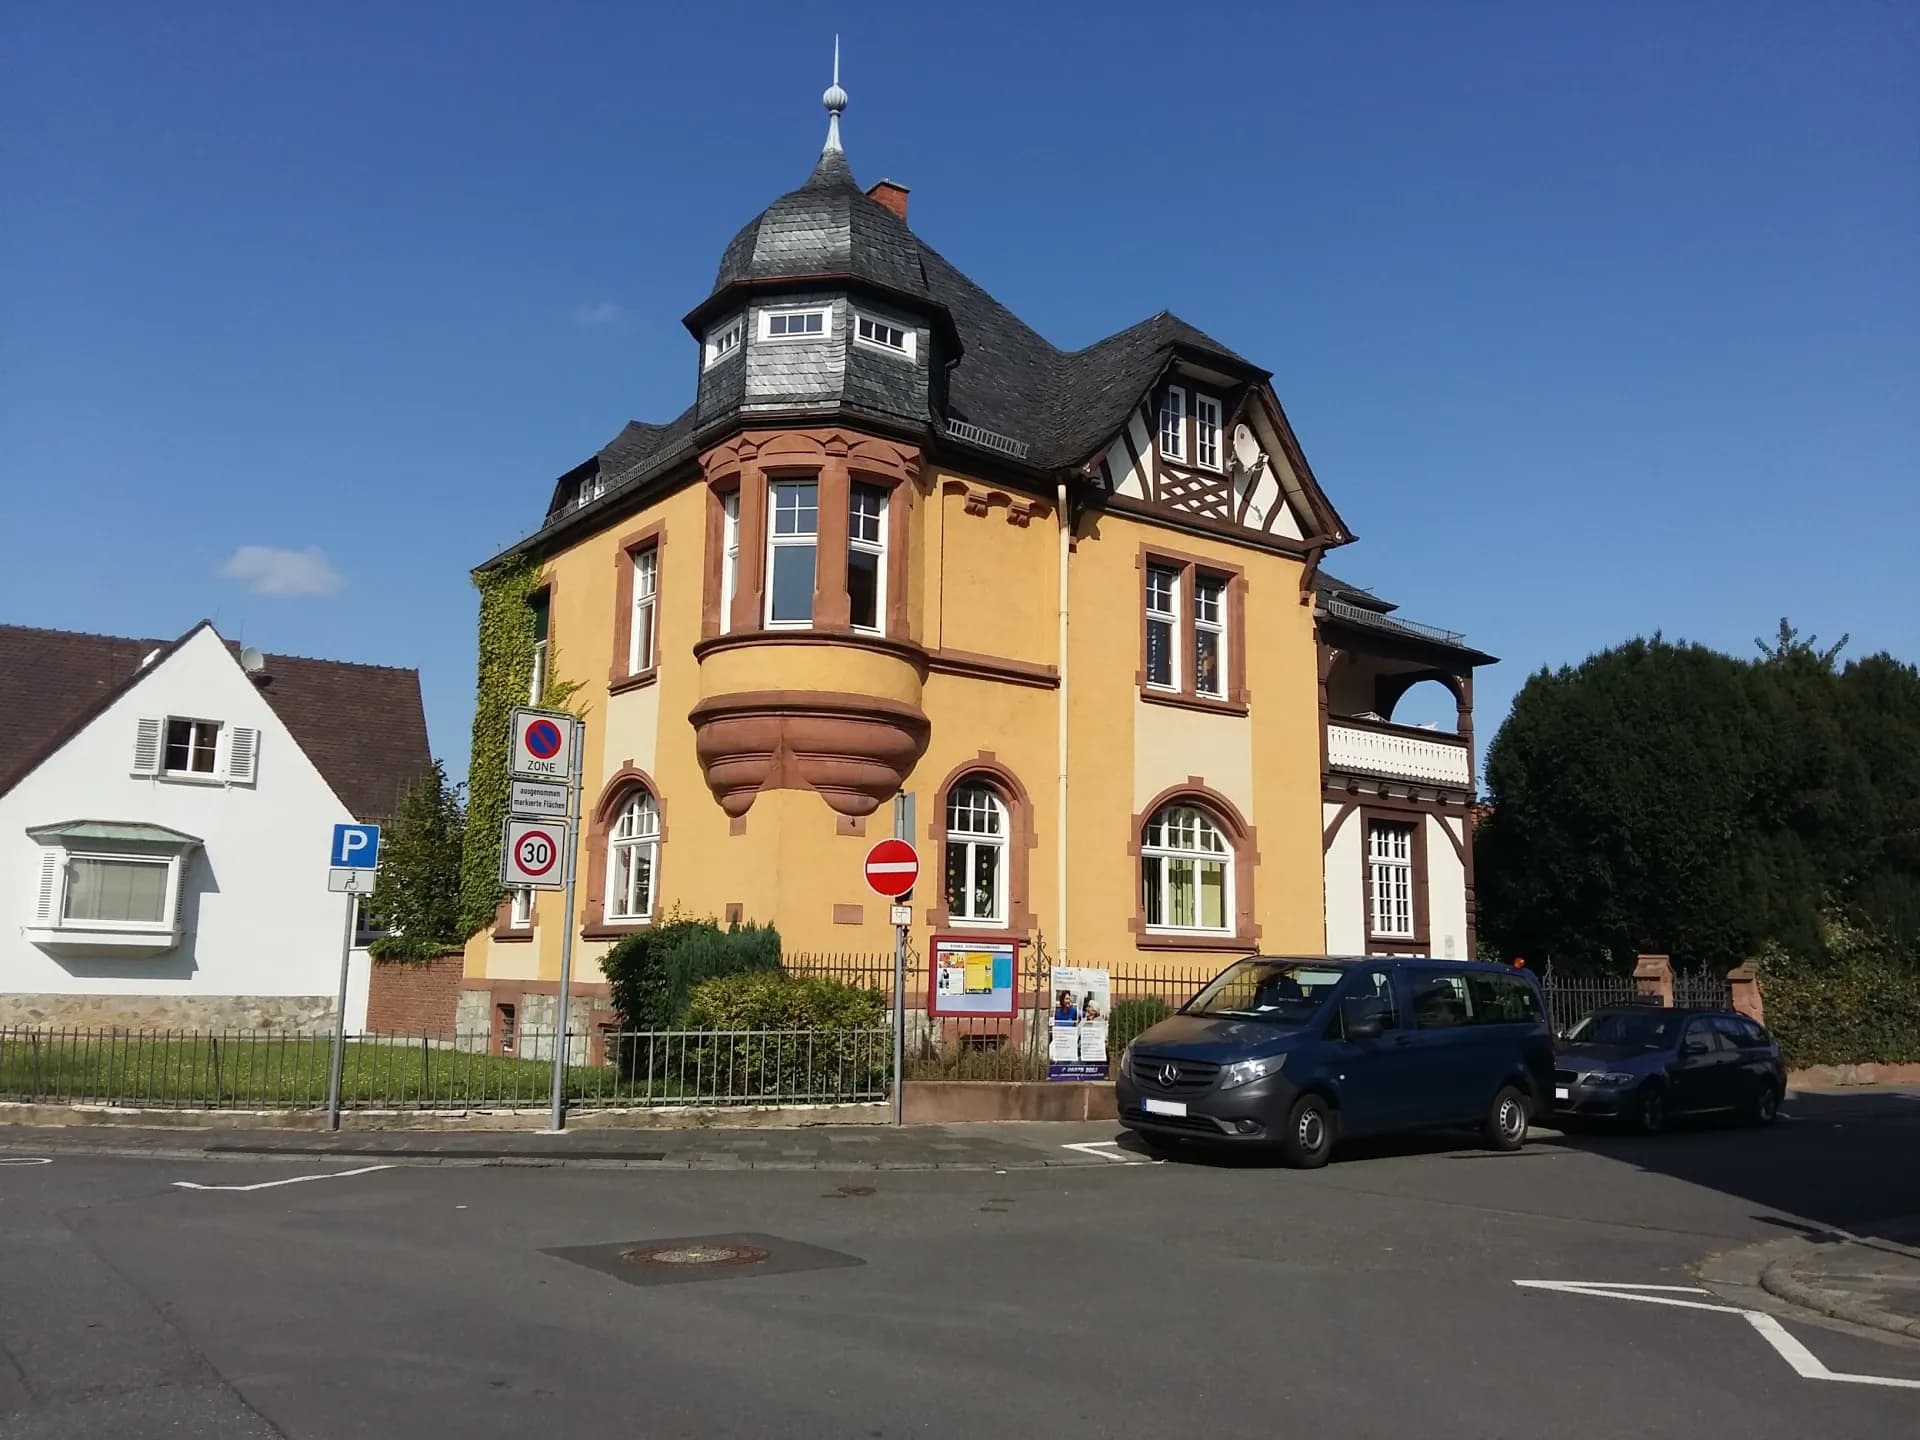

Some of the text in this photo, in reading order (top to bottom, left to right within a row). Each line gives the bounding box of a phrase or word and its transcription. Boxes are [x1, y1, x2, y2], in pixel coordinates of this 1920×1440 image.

[528, 760, 556, 773] ZONE
[520, 788, 561, 797] ausgenommen
[514, 798, 566, 809] markierte Flächen
[341, 829, 368, 862] P
[523, 842, 548, 865] 30
